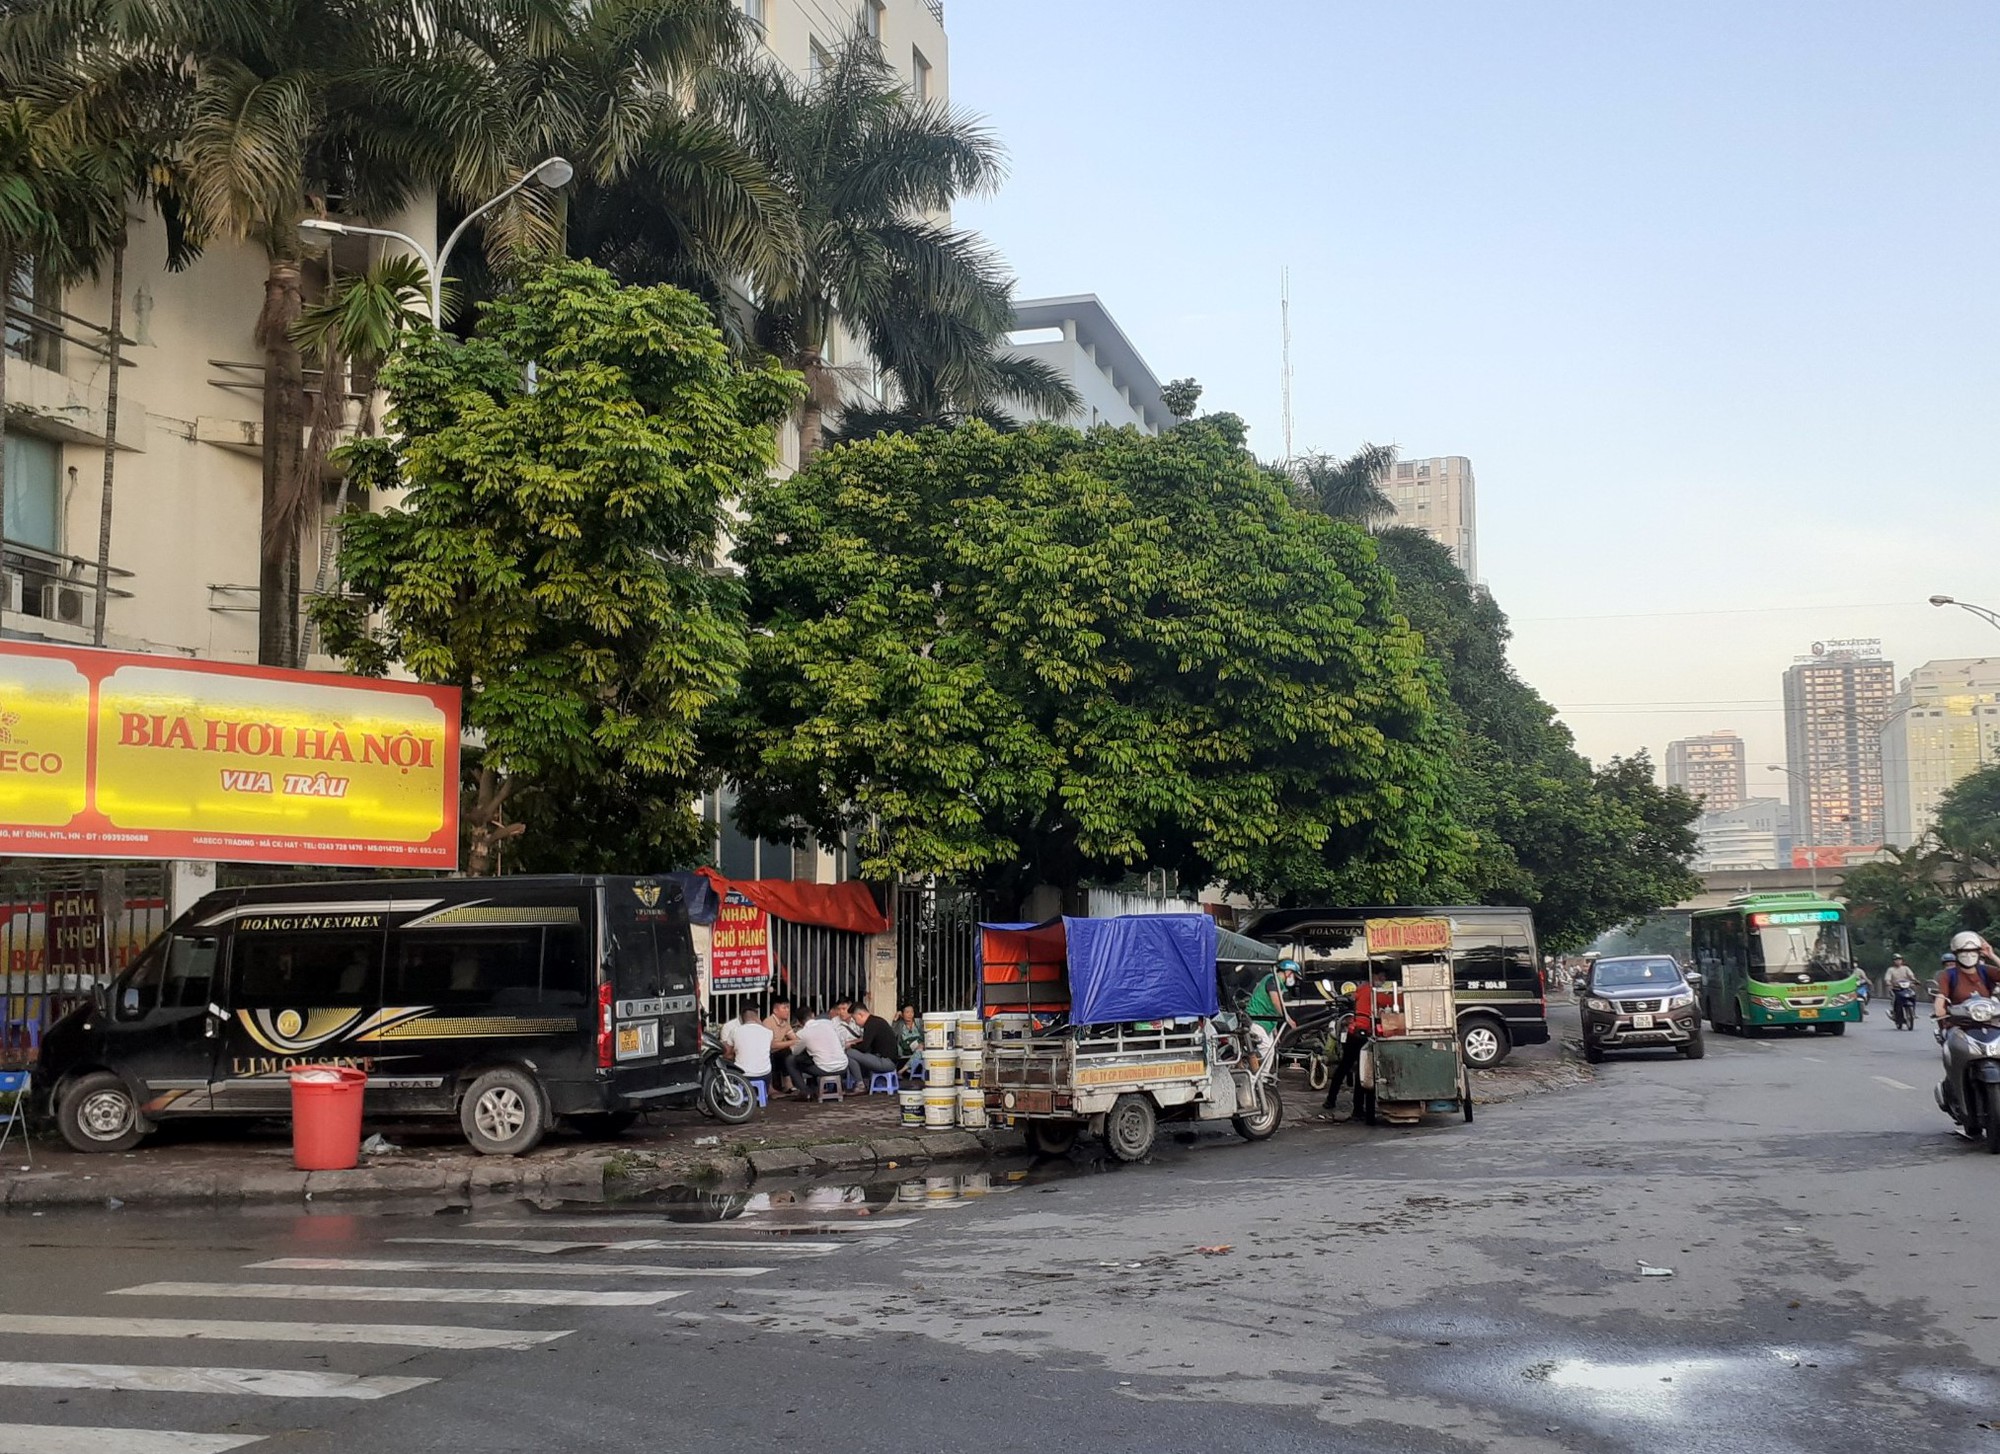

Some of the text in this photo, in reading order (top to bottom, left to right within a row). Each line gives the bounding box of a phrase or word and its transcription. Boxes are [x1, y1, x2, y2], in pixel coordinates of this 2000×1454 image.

[118, 711, 435, 775] BIA HƠI HÀ NỘI
[220, 768, 350, 798] VUA TRÂU
[68, 832, 81, 840] HN
[192, 836, 223, 845] HABECO
[224, 837, 255, 847] TRADING
[284, 841, 298, 849] HAT
[303, 842, 317, 850] TEL:
[322, 915, 381, 929] EXPREX
[721, 905, 758, 925] NHẬN
[713, 924, 737, 948] CHỞ
[643, 1002, 679, 1014] DCAR
[232, 1056, 377, 1075] LIMOUSINE
